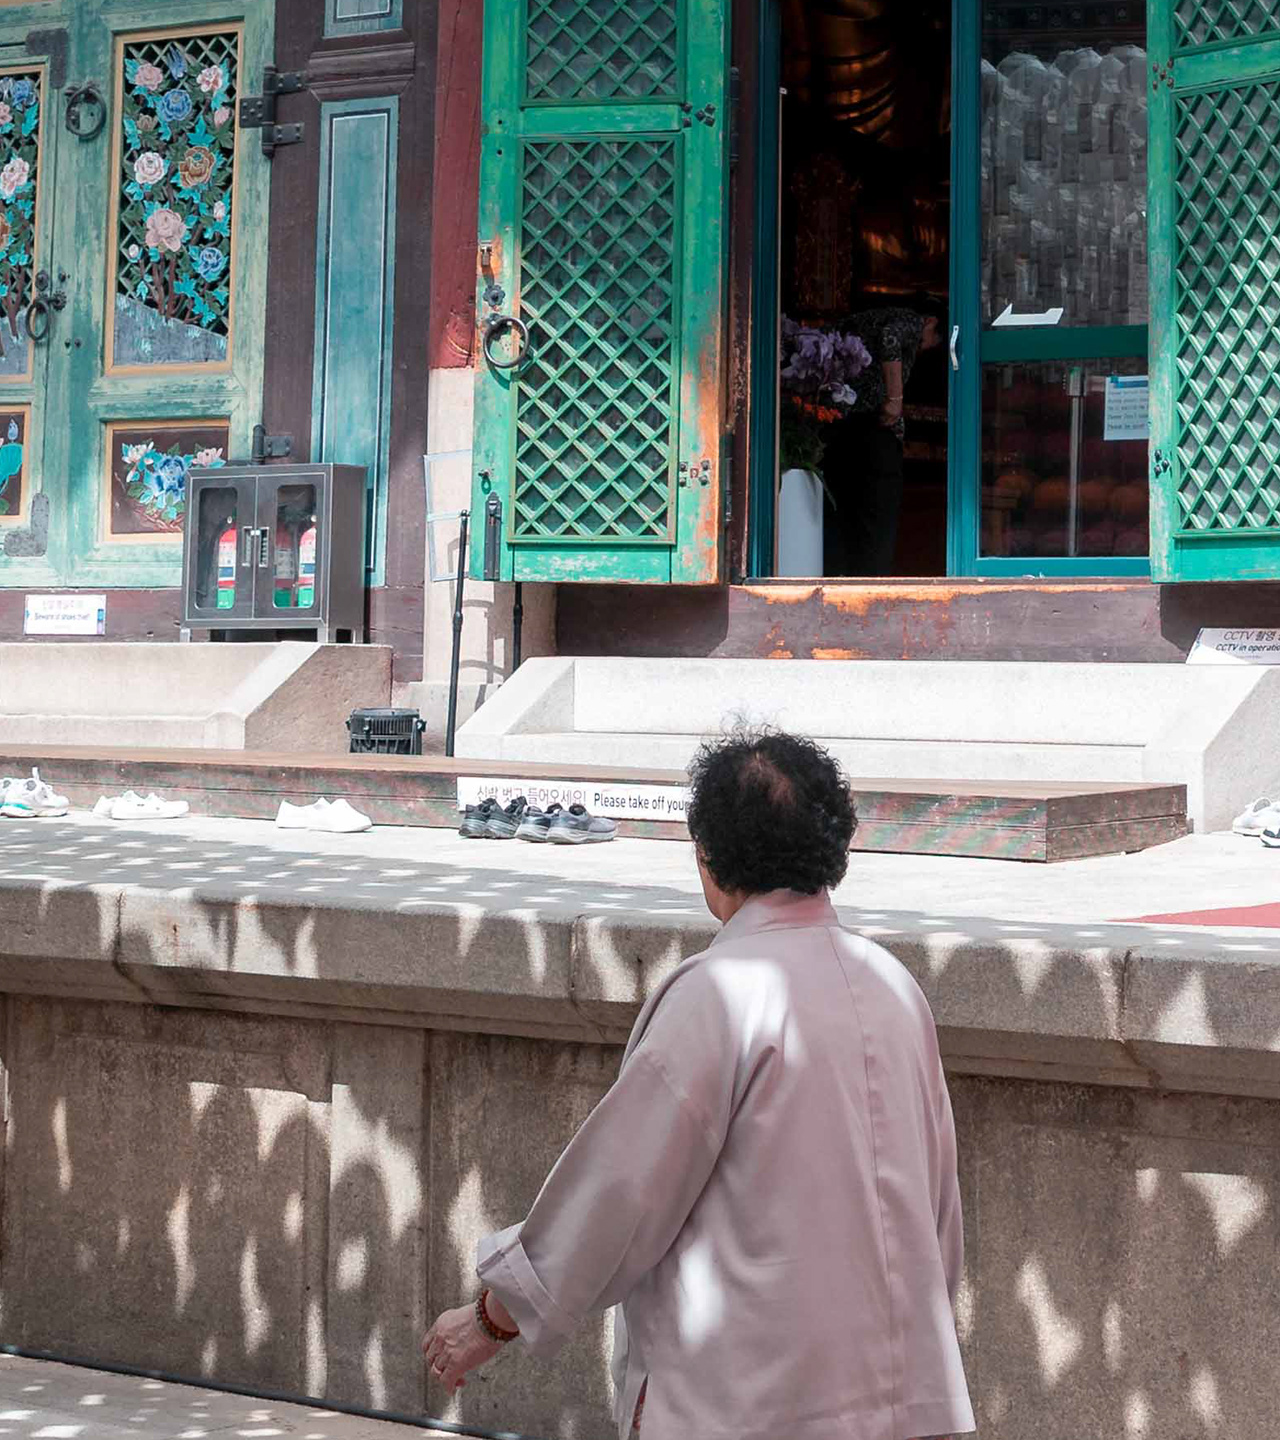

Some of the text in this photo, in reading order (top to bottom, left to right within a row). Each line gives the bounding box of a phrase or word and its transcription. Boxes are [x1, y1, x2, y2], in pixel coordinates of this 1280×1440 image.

[1223, 630, 1255, 641] CCTV
[1216, 643, 1239, 652] CCTV
[594, 792, 626, 809] Please
[628, 794, 651, 810] take
[651, 794, 666, 811] off
